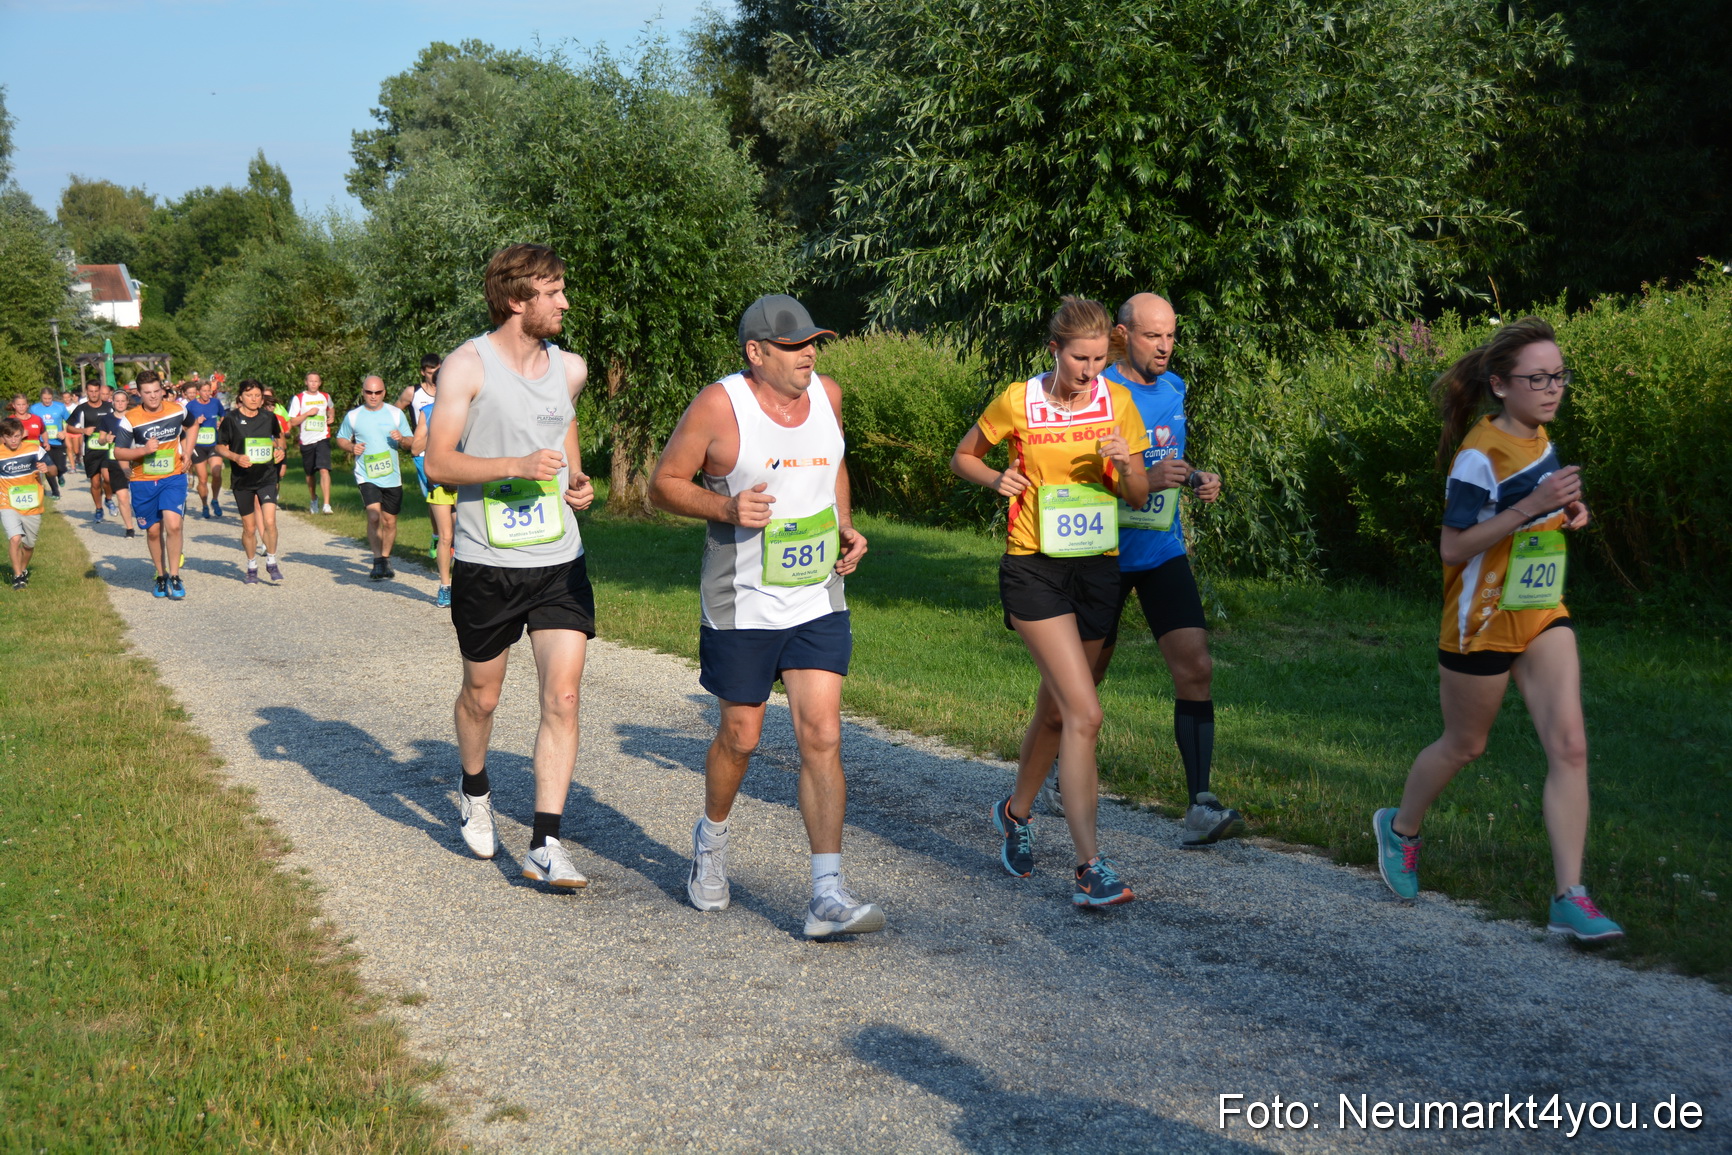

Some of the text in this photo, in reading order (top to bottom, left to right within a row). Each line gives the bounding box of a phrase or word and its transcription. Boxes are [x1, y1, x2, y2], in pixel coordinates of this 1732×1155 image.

[1028, 432, 1067, 445] MAX
[249, 448, 271, 456] 1188
[1144, 446, 1178, 460] camping
[8, 461, 32, 472] Fischer
[149, 460, 169, 468] 443
[368, 460, 391, 472] 1435
[15, 494, 33, 503] 445
[502, 502, 545, 529] 351
[1057, 512, 1103, 537] 894
[781, 540, 825, 569] 581
[1520, 562, 1556, 588] 420
